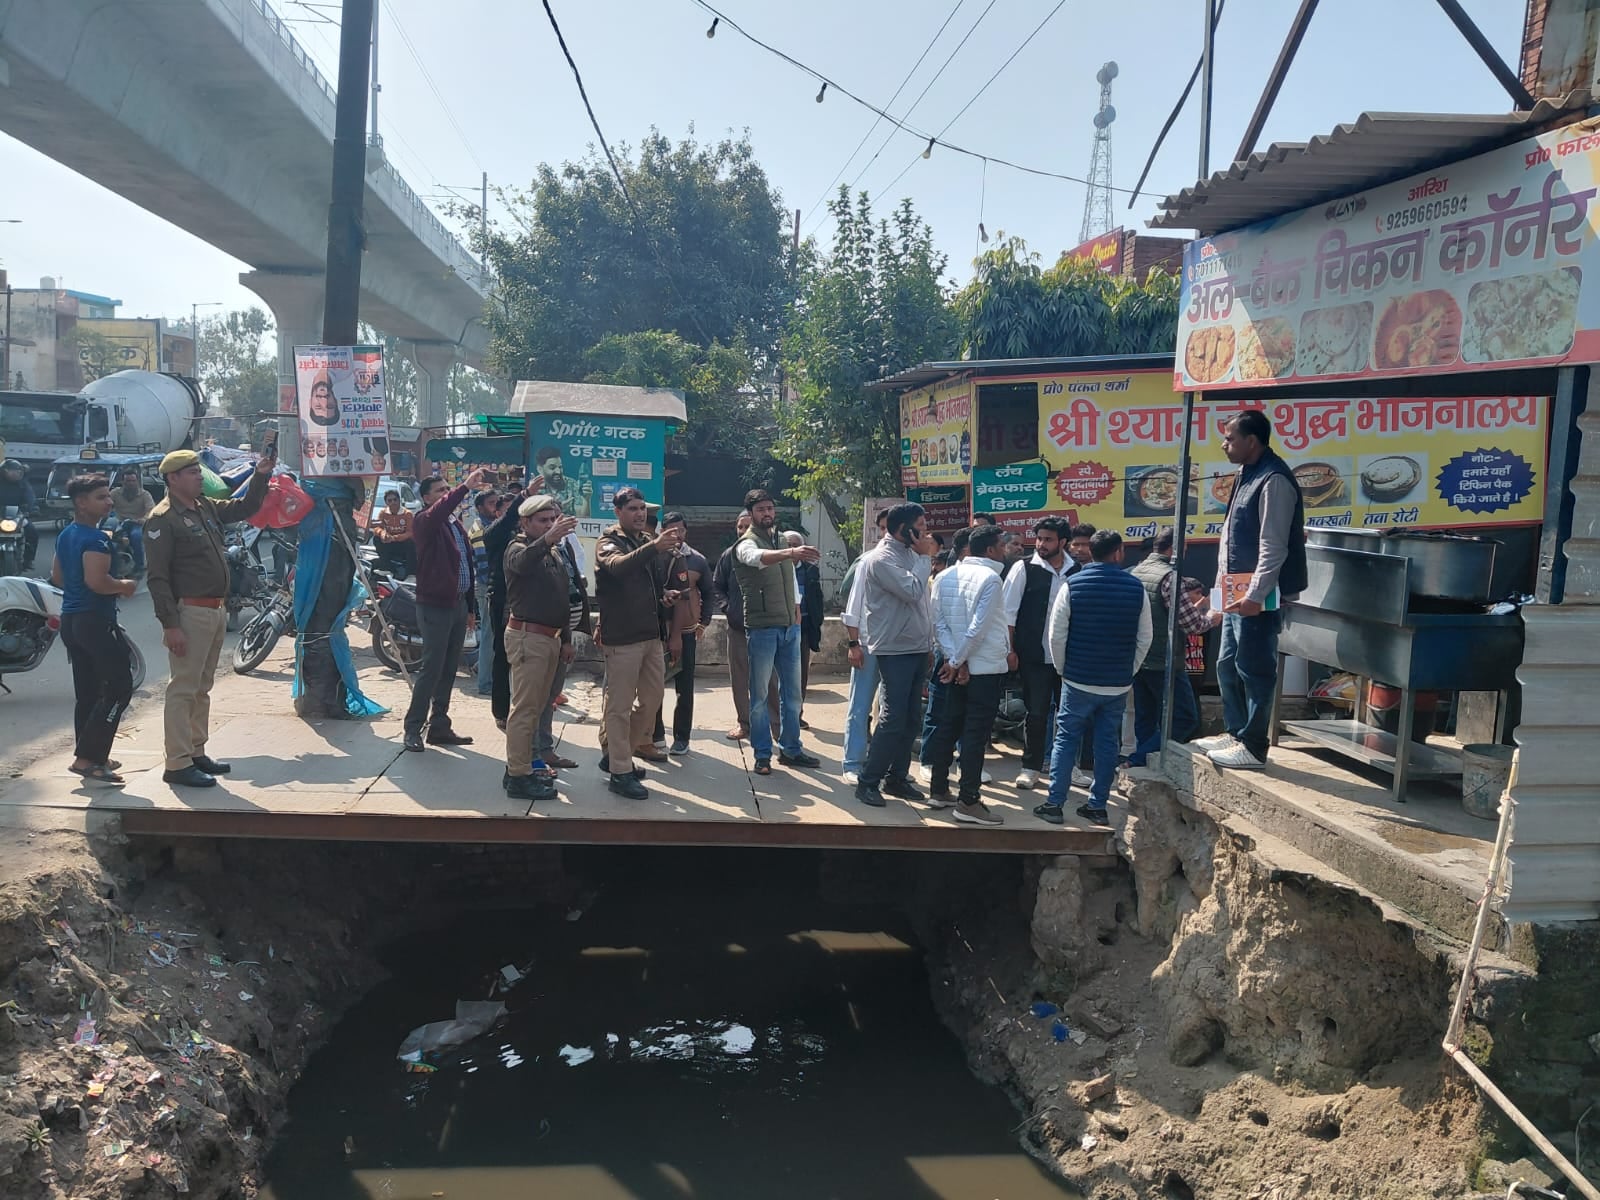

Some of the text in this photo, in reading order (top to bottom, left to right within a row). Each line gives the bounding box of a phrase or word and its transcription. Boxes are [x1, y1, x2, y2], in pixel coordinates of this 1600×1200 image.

[1408, 177, 1448, 201] आरिश
[1387, 194, 1468, 230] 9259660594
[1314, 228, 1430, 299] चिकन
[1439, 169, 1597, 274] कॉर्नर
[1104, 377, 1131, 391] शर्मा
[549, 419, 646, 440] Sprite गटक
[1048, 399, 1100, 446] श्री
[1274, 400, 1349, 450] शुद्ध
[569, 440, 628, 459] ठंड रख
[995, 465, 1023, 478] लंच
[1462, 466, 1488, 477] हमारे
[976, 482, 1044, 496] ब्रेकफास्ट
[1459, 477, 1512, 490] टिफिन पैक
[1072, 489, 1098, 499] दाल
[1453, 493, 1476, 504] किये
[1478, 493, 1501, 503] जाते
[991, 497, 1029, 510] डिनर
[580, 522, 601, 533] पान
[1126, 521, 1157, 537] शाही
[1363, 512, 1389, 526] तवा
[1391, 507, 1419, 523] रोटी
